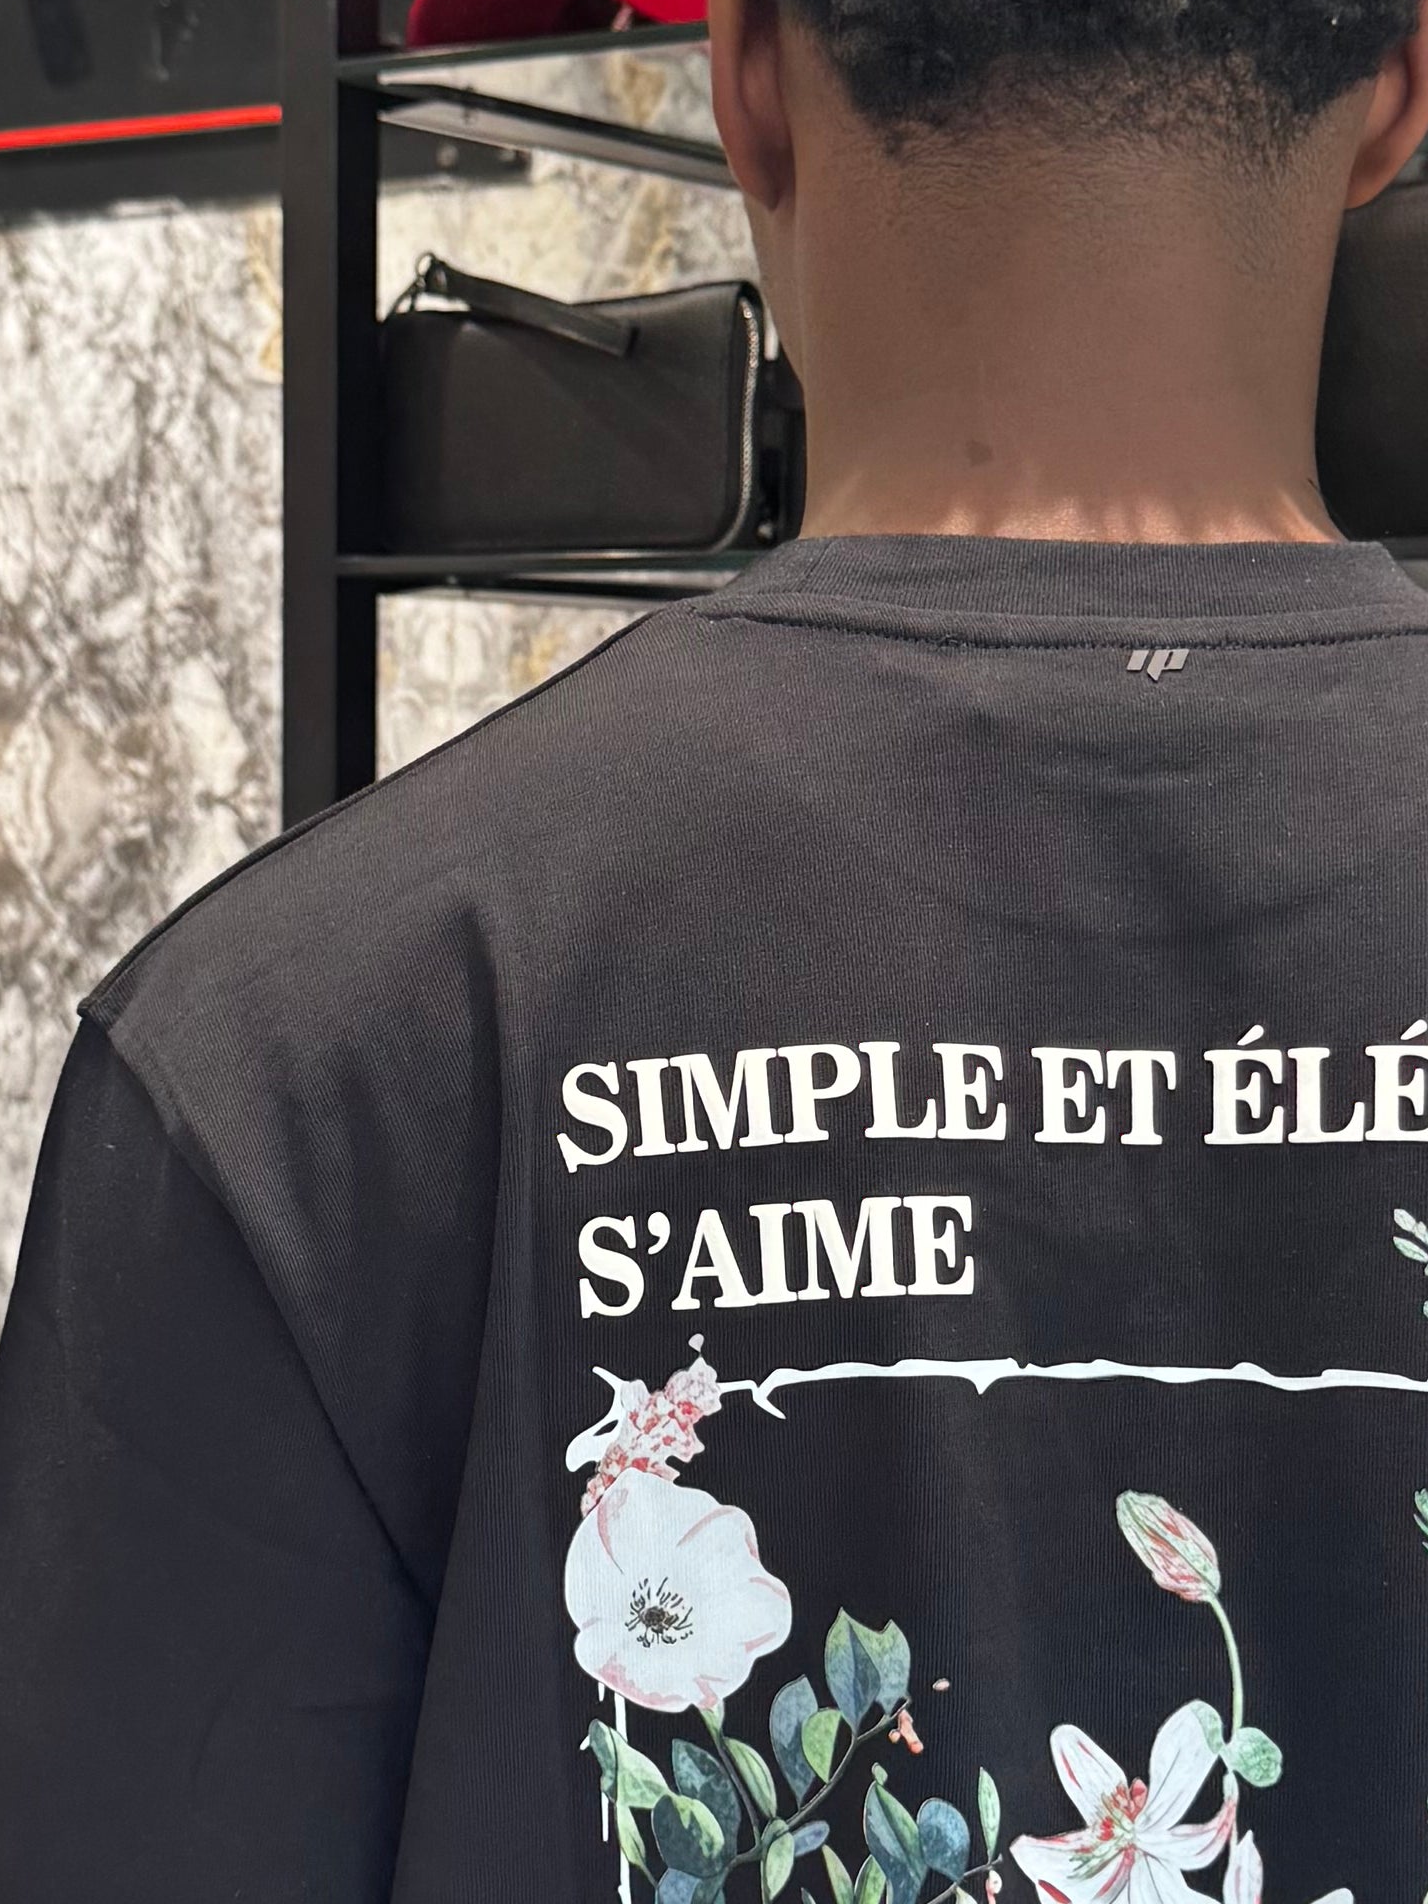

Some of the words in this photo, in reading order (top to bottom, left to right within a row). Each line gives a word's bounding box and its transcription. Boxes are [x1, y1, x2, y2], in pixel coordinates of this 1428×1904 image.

[556, 1041, 1007, 1174] SIMPLE
[1030, 1046, 1177, 1146] ET
[578, 1195, 975, 1319] S'AIME
